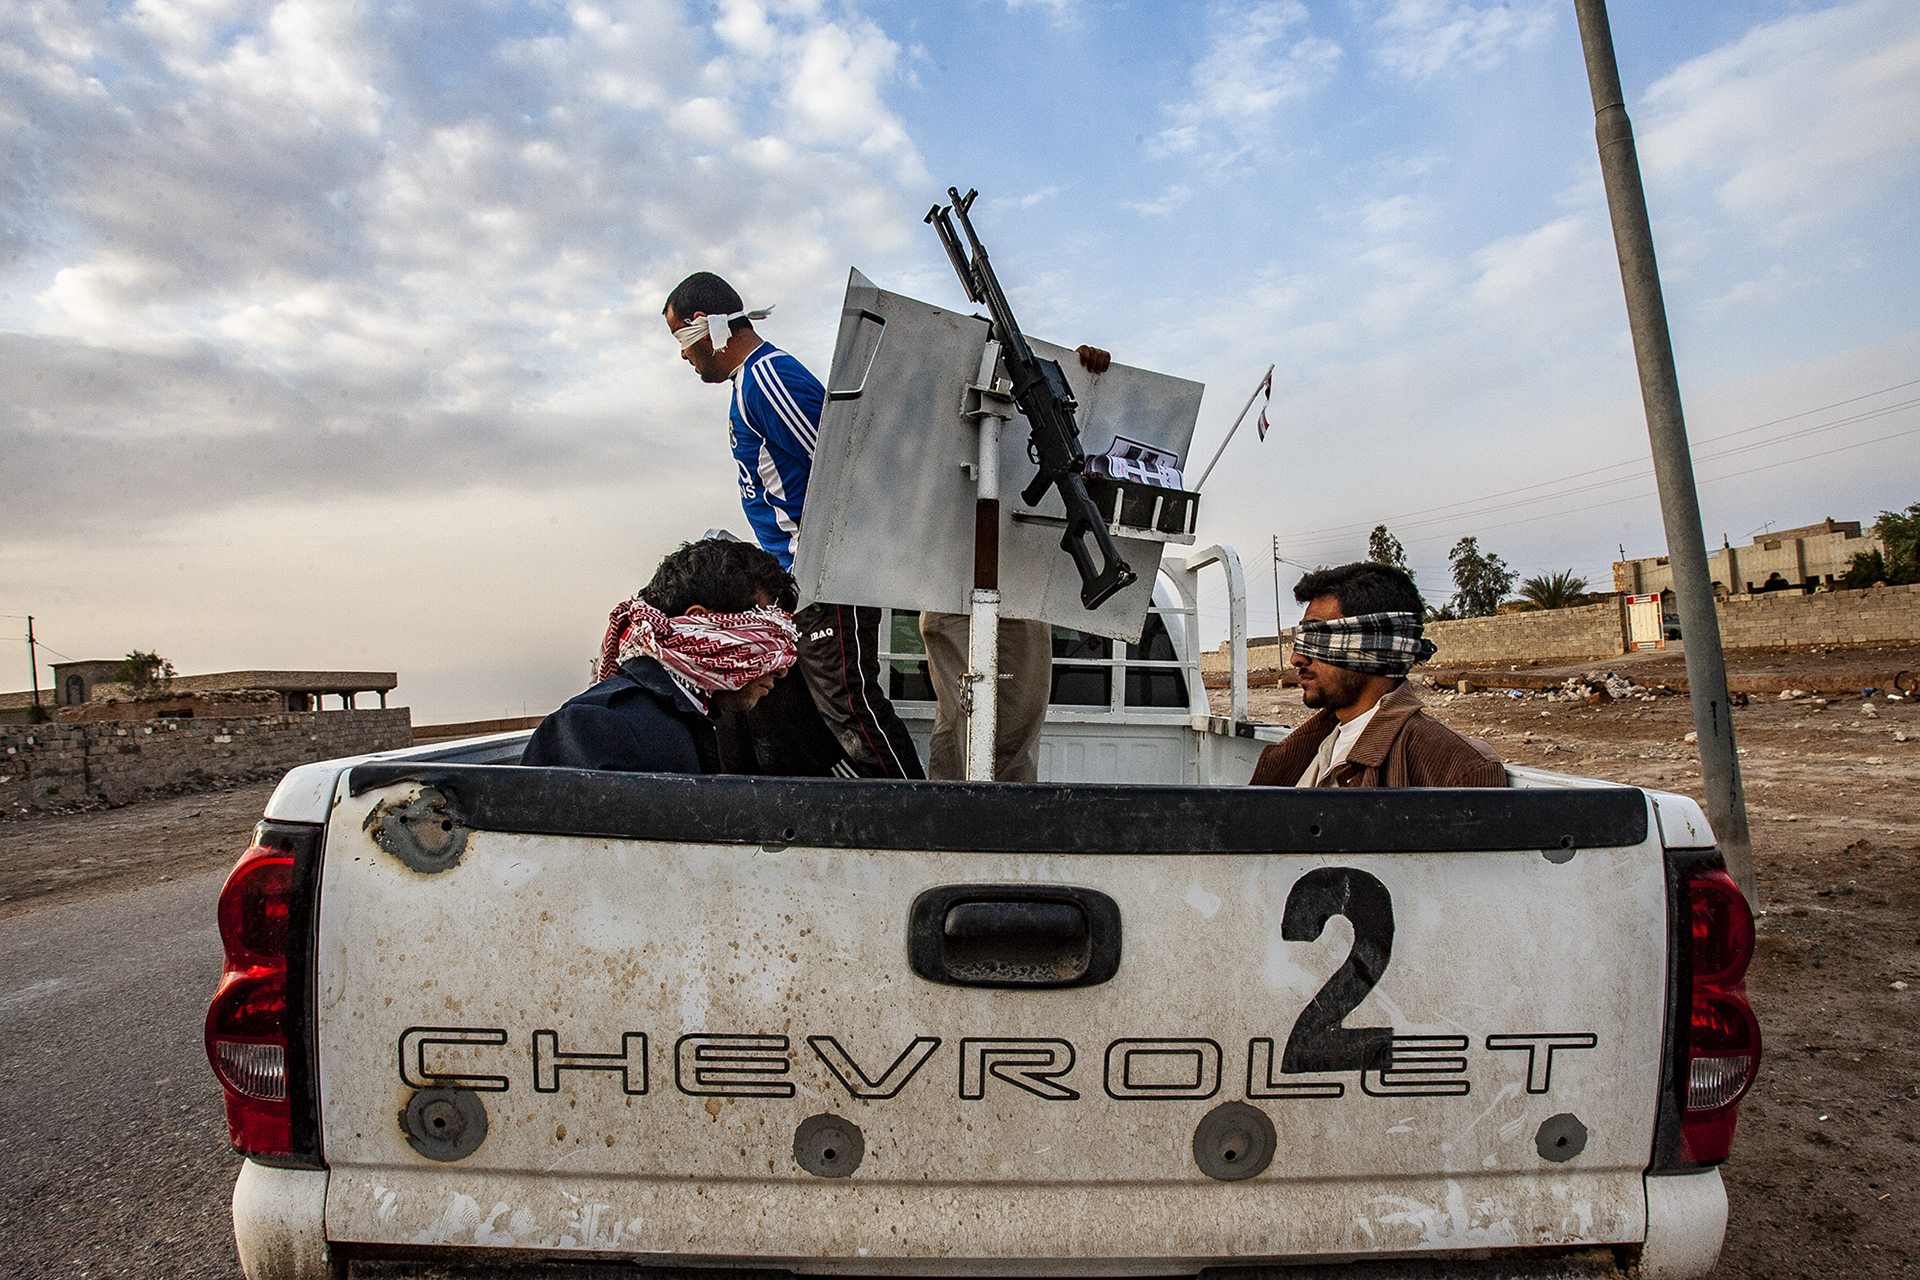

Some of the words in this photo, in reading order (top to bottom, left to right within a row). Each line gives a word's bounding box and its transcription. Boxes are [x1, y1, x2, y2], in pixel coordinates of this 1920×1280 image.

[810, 627, 834, 642] IRAQ
[1281, 866, 1395, 1074] 2
[398, 1026, 1598, 1102] CHEVROLET
